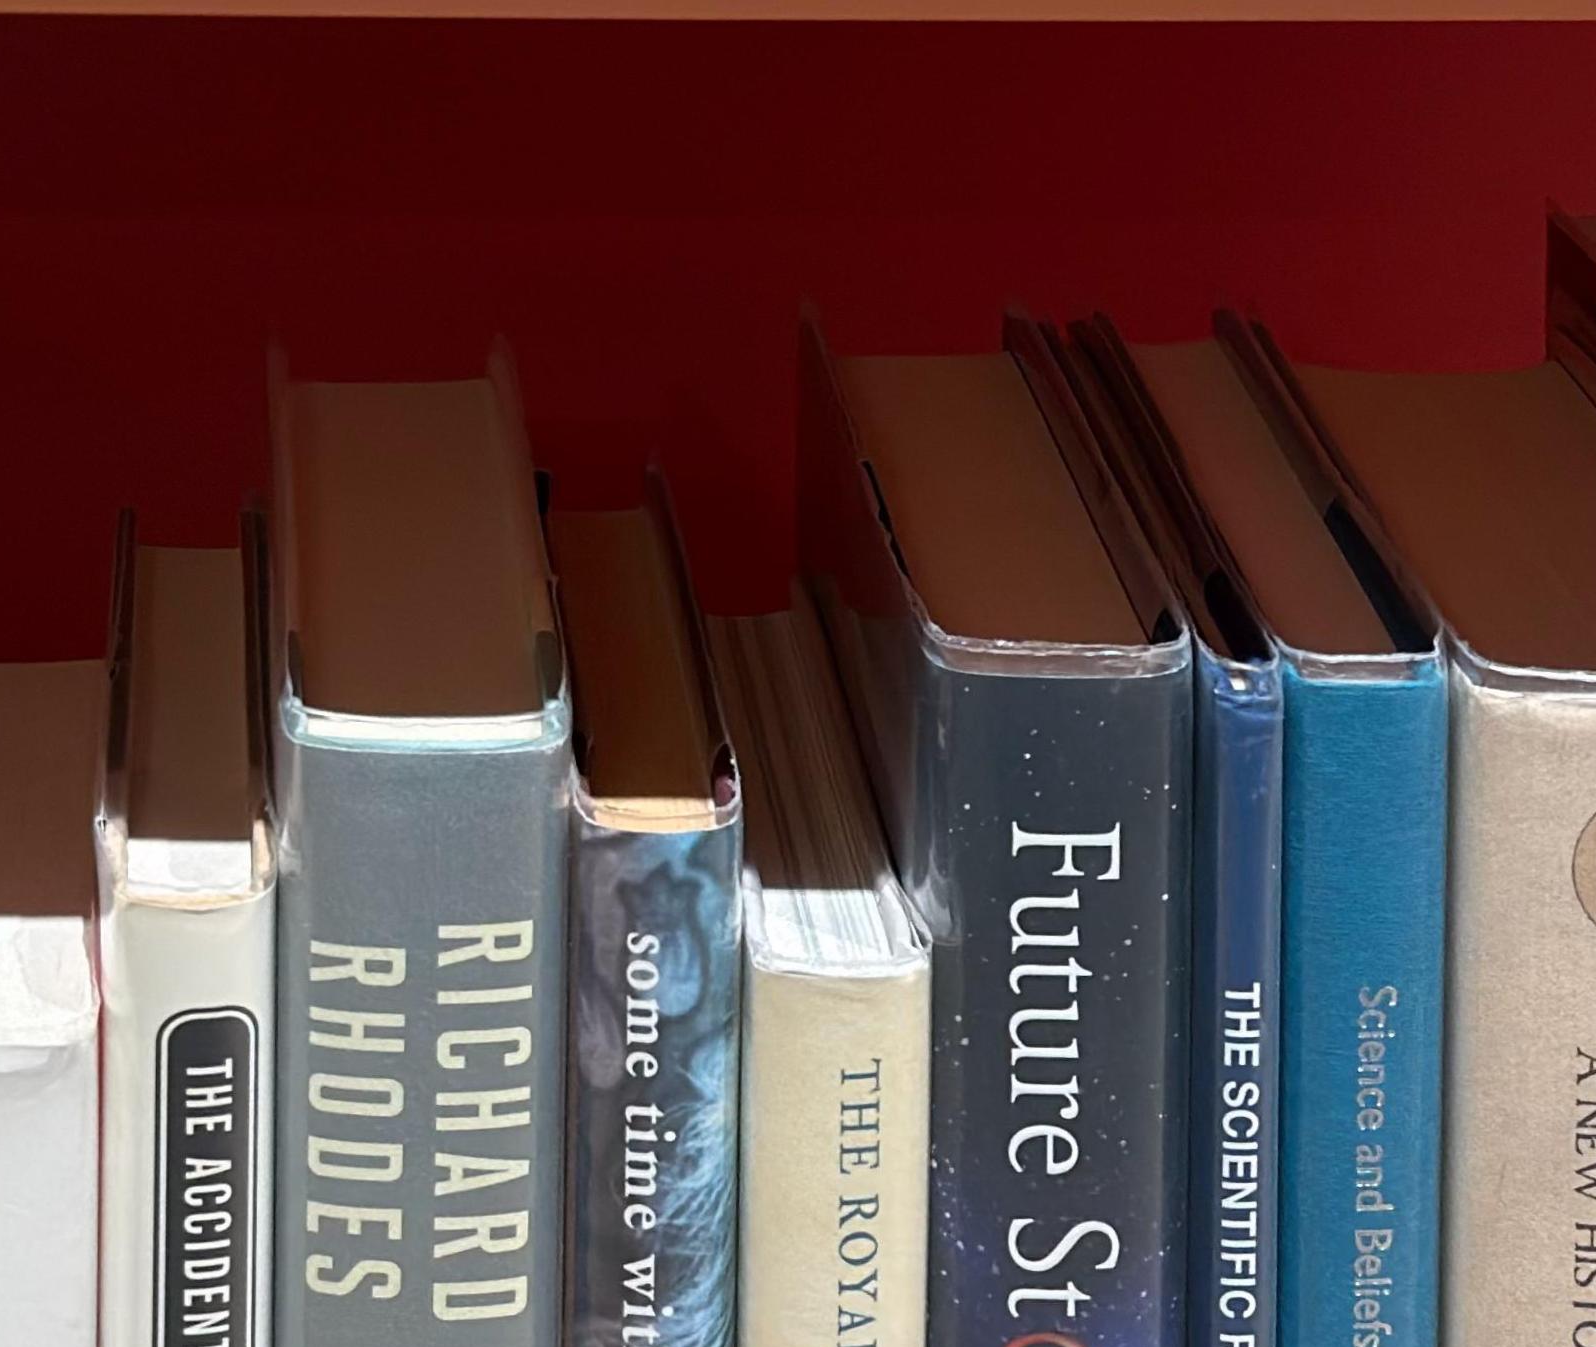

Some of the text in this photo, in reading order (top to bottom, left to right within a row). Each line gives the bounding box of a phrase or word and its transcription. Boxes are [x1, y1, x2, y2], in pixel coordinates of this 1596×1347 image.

[625, 931, 660, 1079] some
[1008, 821, 1121, 1175] Future
[1224, 982, 1261, 1067] THE
[1357, 985, 1398, 1131] Science
[185, 1058, 233, 1136] THE
[305, 940, 406, 1300] RHODES
[433, 920, 534, 1321] RICHARD
[624, 1102, 675, 1232] time
[839, 1058, 881, 1175] THE
[1219, 1080, 1260, 1321] SCIENTIFIC
[1355, 1145, 1393, 1212] and
